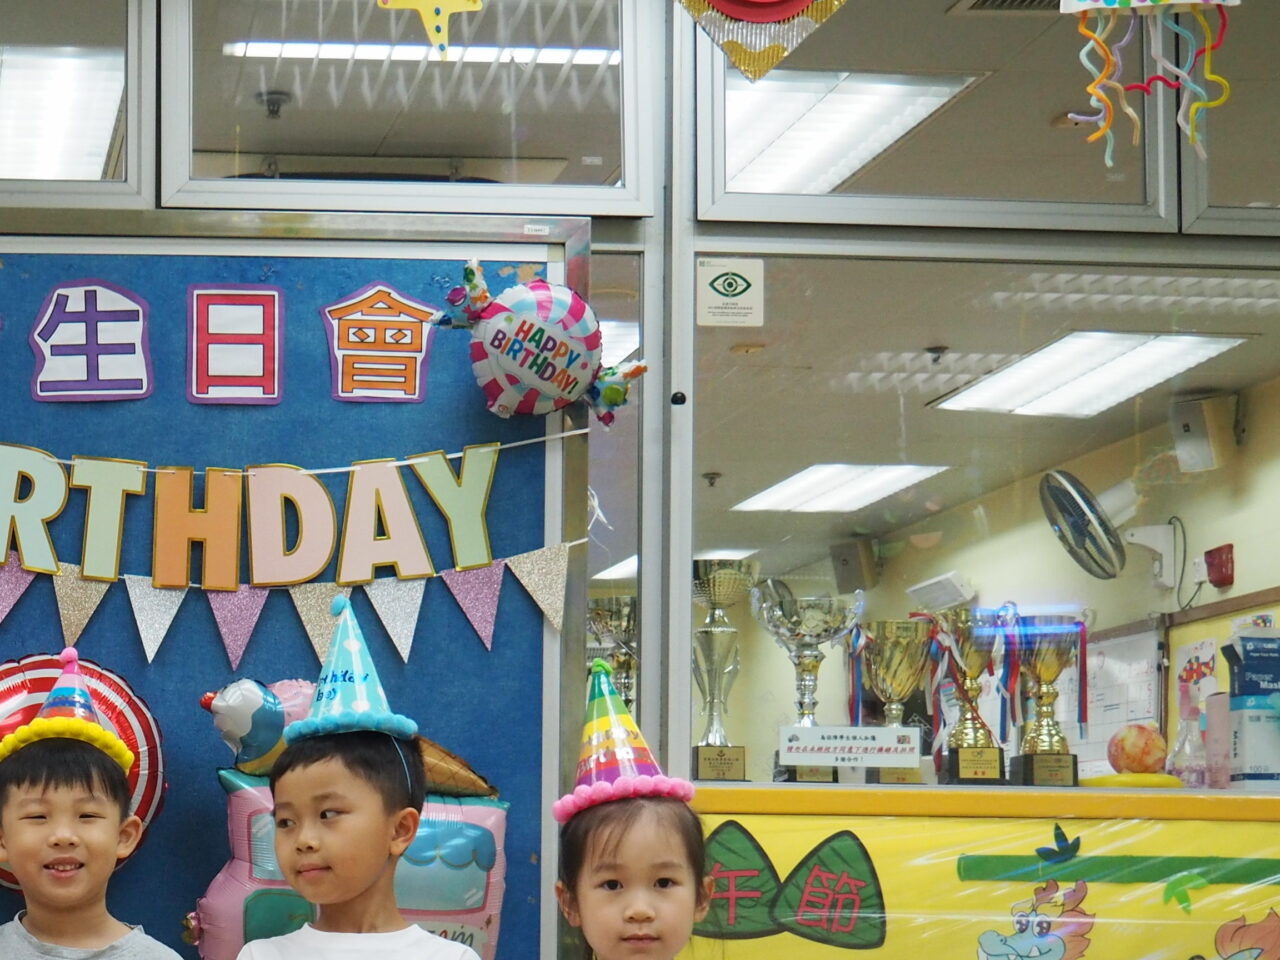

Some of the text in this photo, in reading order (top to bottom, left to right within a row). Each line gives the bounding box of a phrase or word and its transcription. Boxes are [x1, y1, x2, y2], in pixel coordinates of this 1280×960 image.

[489, 329, 579, 395] BIRTHDAY!
[515, 320, 581, 369] HAPPY
[710, 862, 868, 933] 午節
